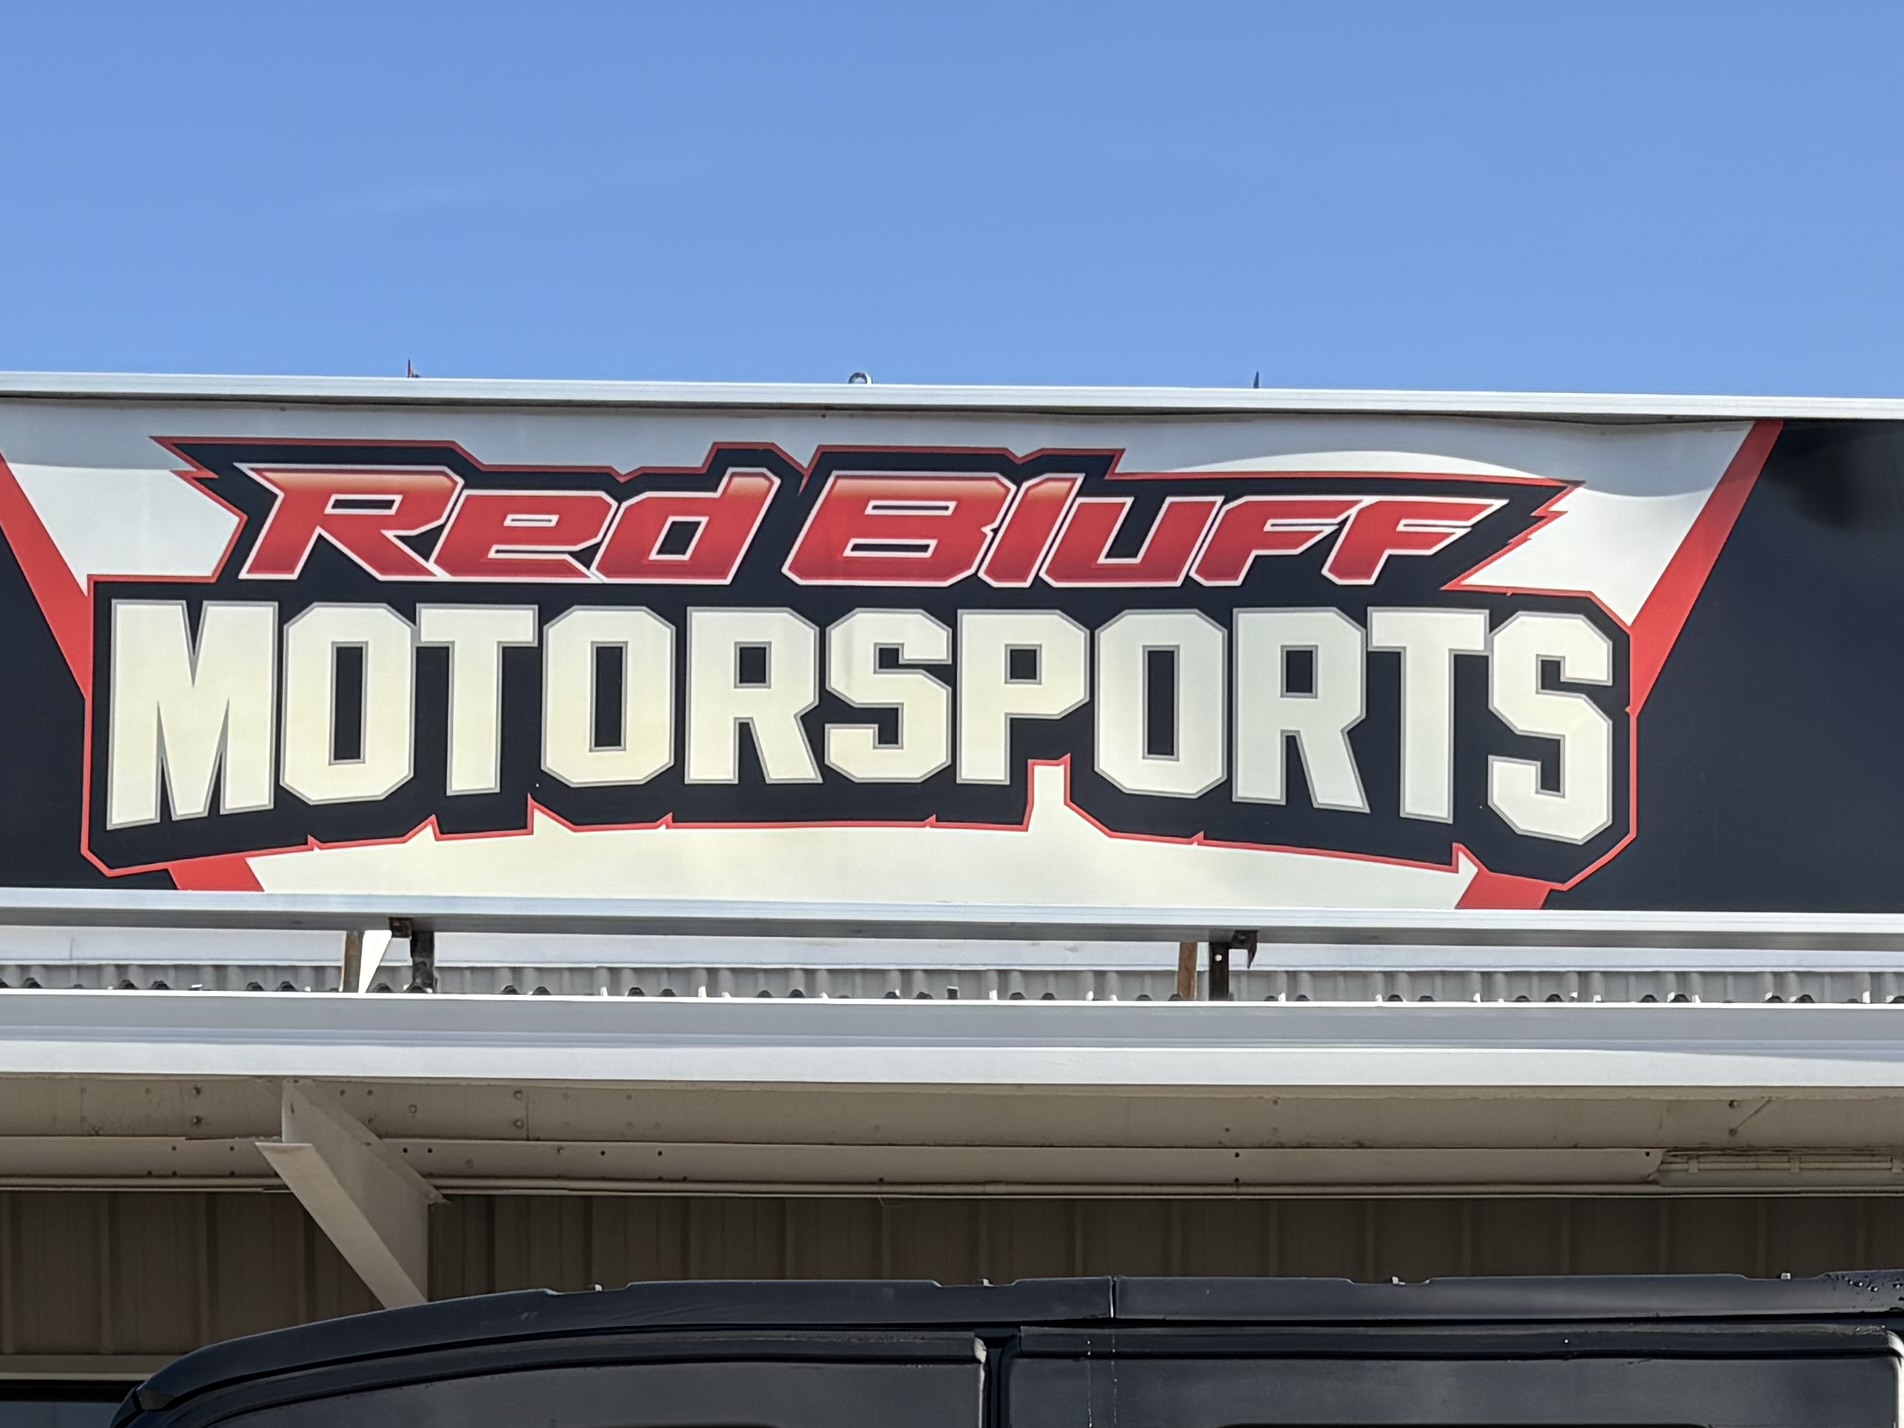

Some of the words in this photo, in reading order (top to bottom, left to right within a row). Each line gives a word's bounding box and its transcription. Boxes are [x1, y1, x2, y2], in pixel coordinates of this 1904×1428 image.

[238, 465, 777, 584] Red
[779, 467, 1508, 589] Bluff
[104, 598, 1616, 842] MOTORSPORTS
